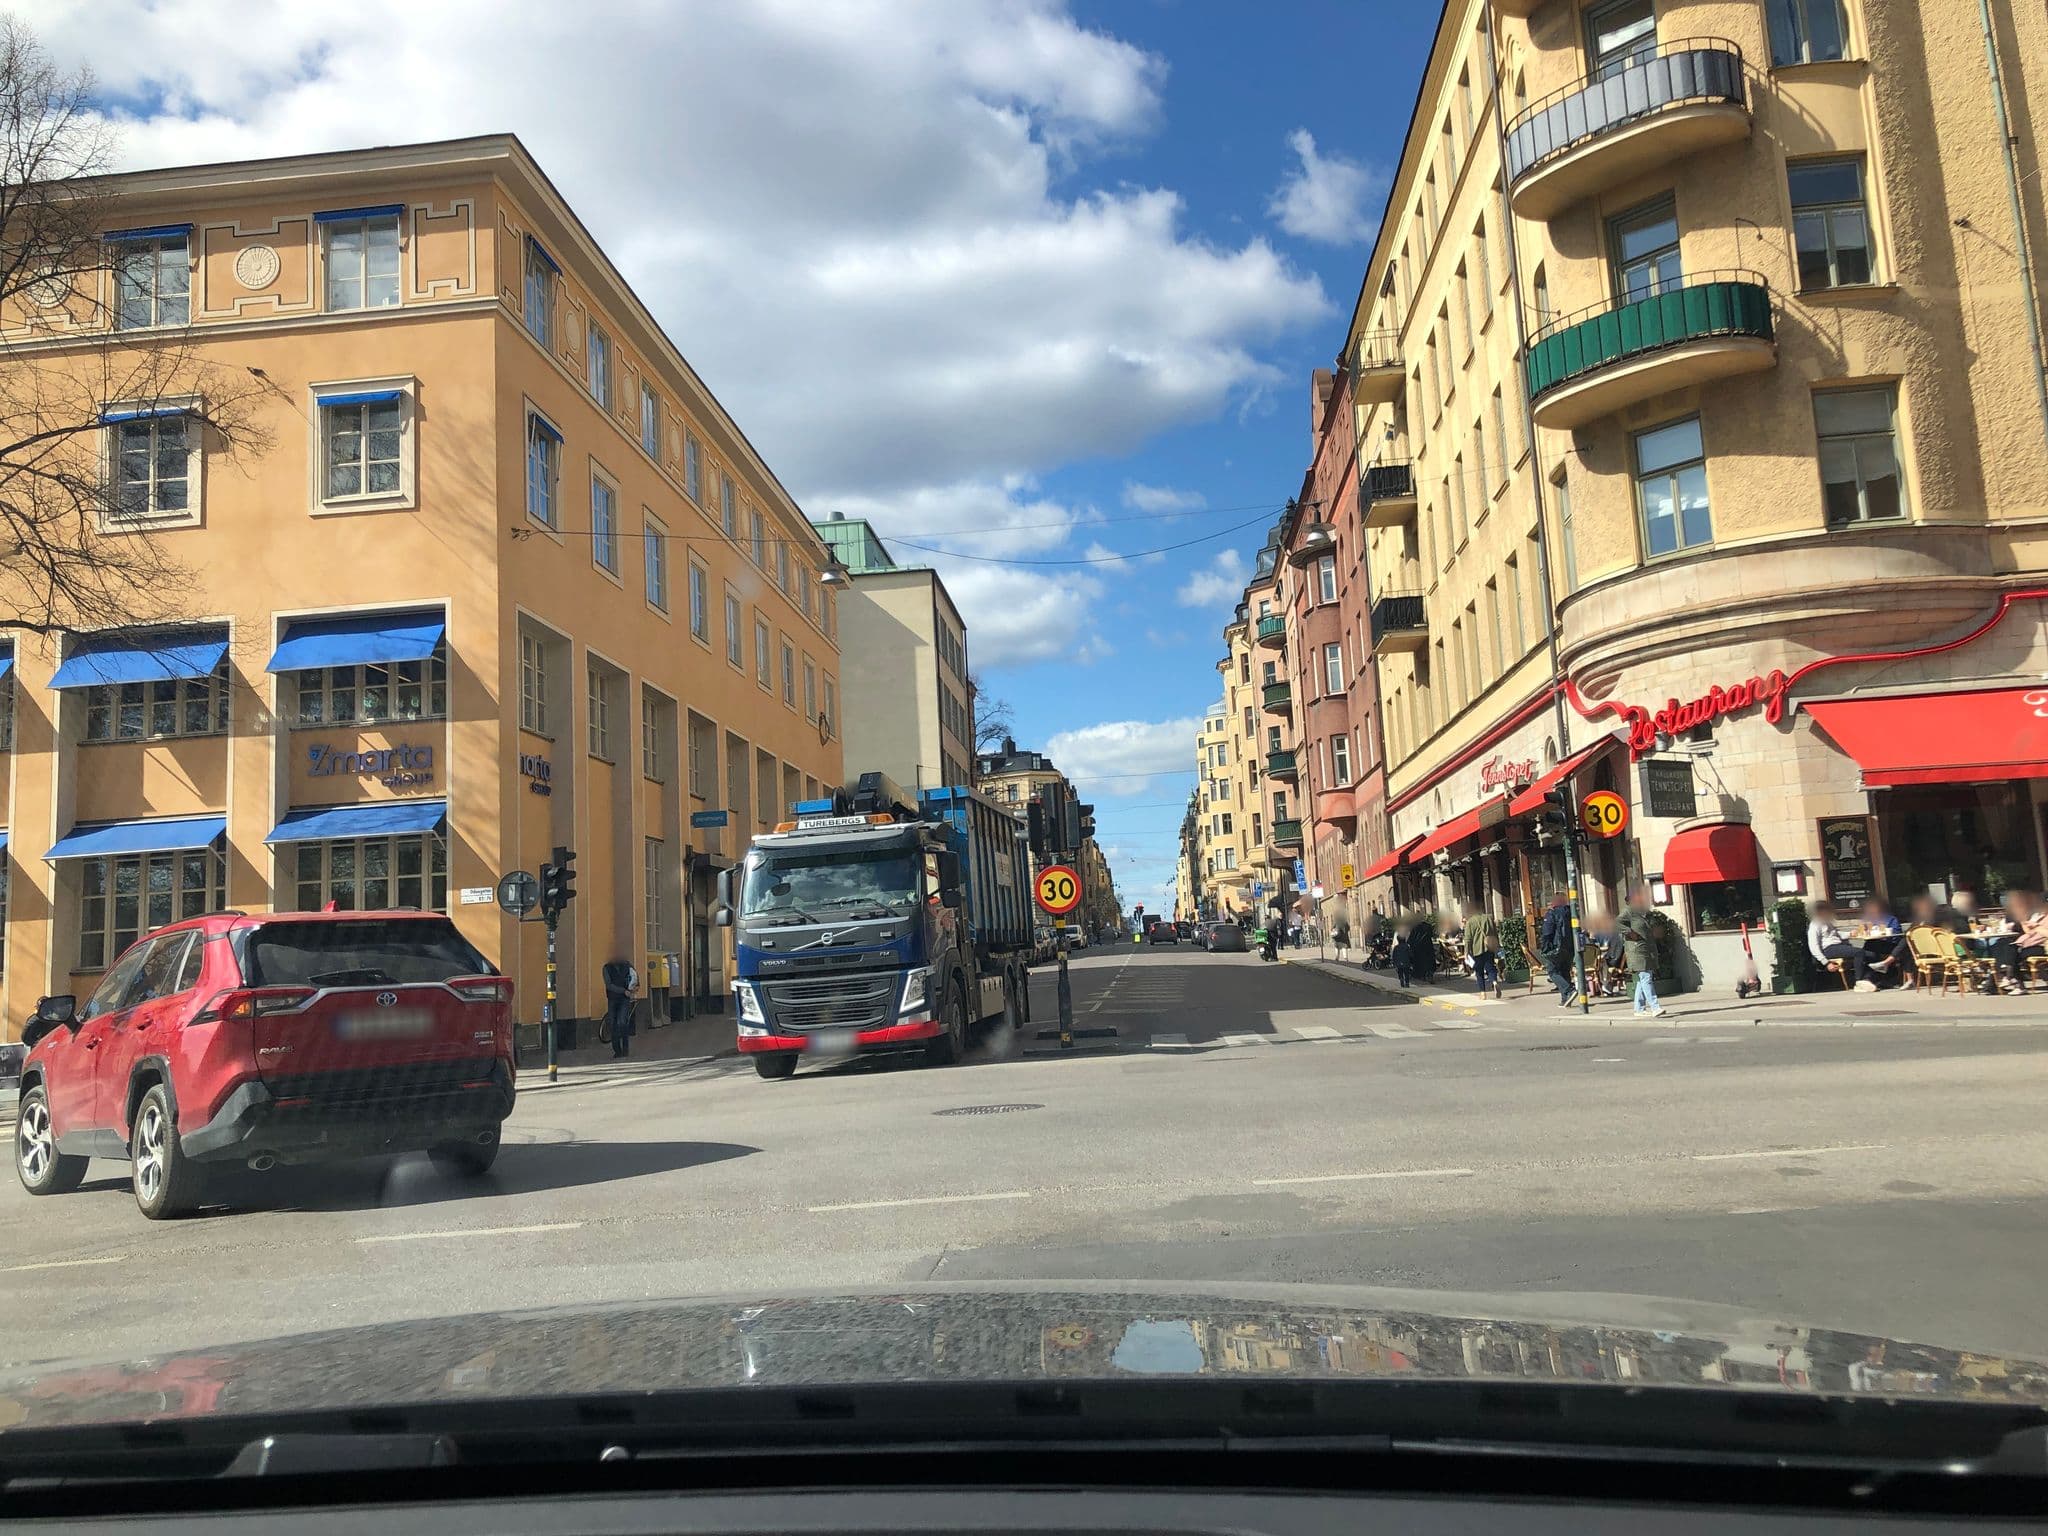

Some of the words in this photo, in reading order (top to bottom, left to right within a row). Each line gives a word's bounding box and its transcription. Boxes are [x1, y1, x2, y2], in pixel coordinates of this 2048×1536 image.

[1623, 669, 1788, 760] Restaurang
[308, 744, 433, 777] Zmarta
[382, 772, 433, 787] GROUP
[803, 817, 861, 828] TUREBERGS
[1587, 803, 1621, 827] 30
[1043, 877, 1075, 902] 30
[762, 959, 787, 967] VOLVO
